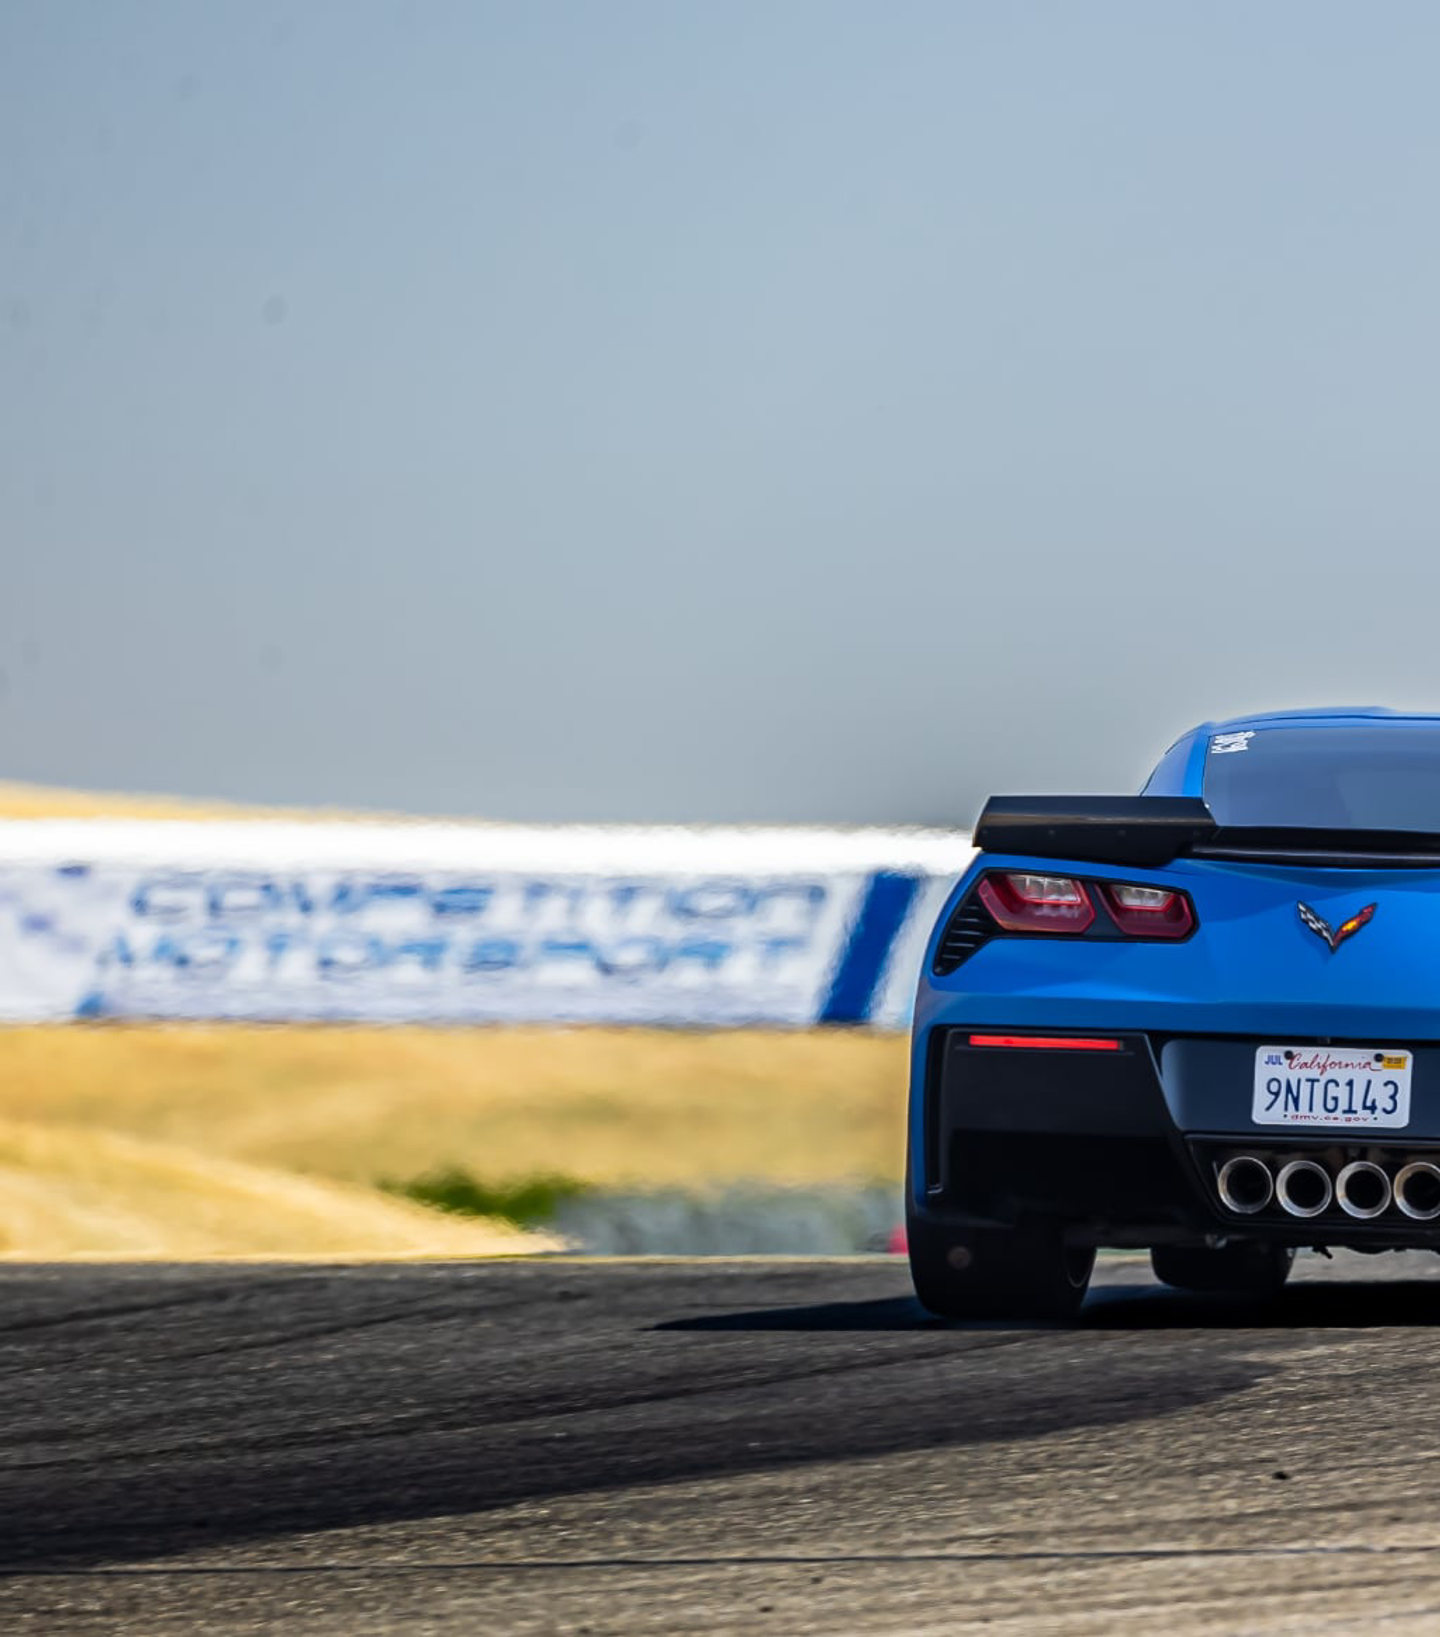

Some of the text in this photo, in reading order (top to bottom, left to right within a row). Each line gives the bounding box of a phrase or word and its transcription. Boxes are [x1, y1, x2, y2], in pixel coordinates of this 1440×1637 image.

[1264, 1054, 1284, 1066] JUL
[1288, 1053, 1382, 1076] California
[1264, 1077, 1399, 1115] 9NTG143
